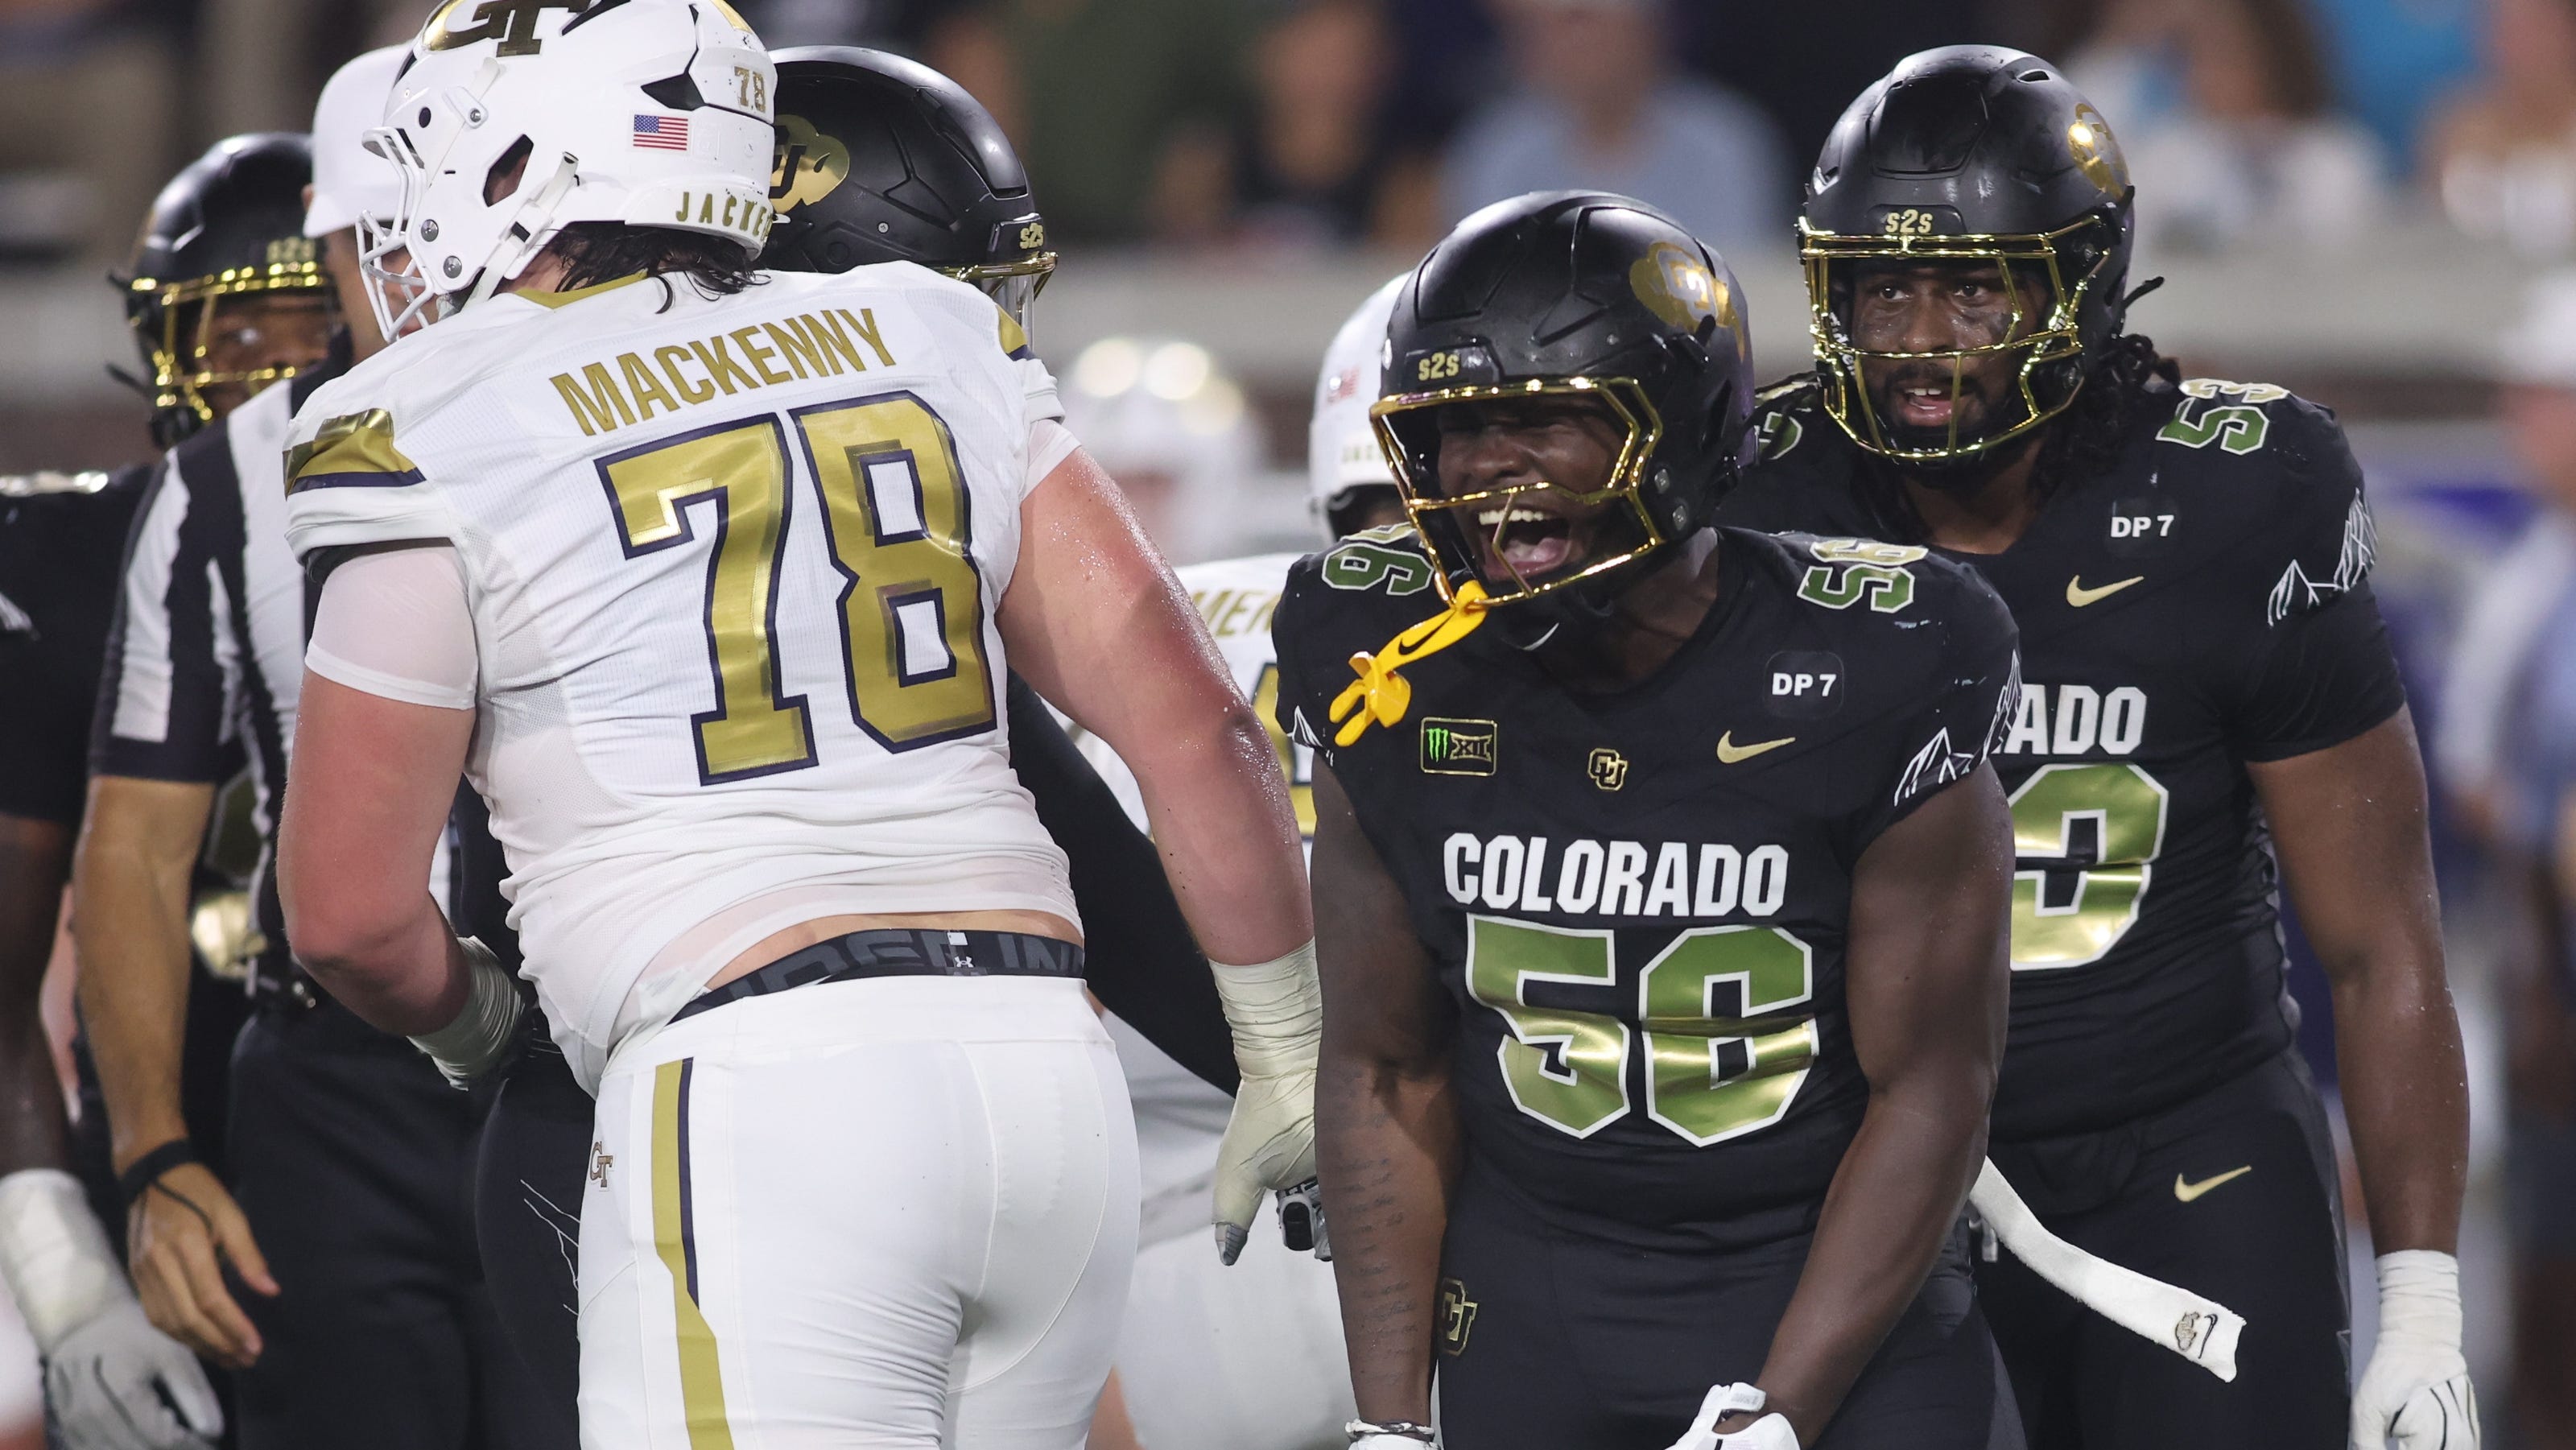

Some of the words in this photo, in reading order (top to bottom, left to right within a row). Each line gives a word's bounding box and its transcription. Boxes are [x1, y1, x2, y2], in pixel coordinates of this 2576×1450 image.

[734, 65, 766, 113] 78
[549, 308, 896, 436] MACKENNY
[2110, 516, 2152, 538] DP
[2157, 514, 2174, 537] 7
[593, 389, 998, 787] 78
[1772, 671, 1814, 696] DP
[1819, 673, 1837, 697] 7
[1990, 683, 2148, 755] ADO
[1443, 832, 1790, 918] COLORADO
[1467, 913, 1820, 1148] 56
[589, 1140, 613, 1188] GT
